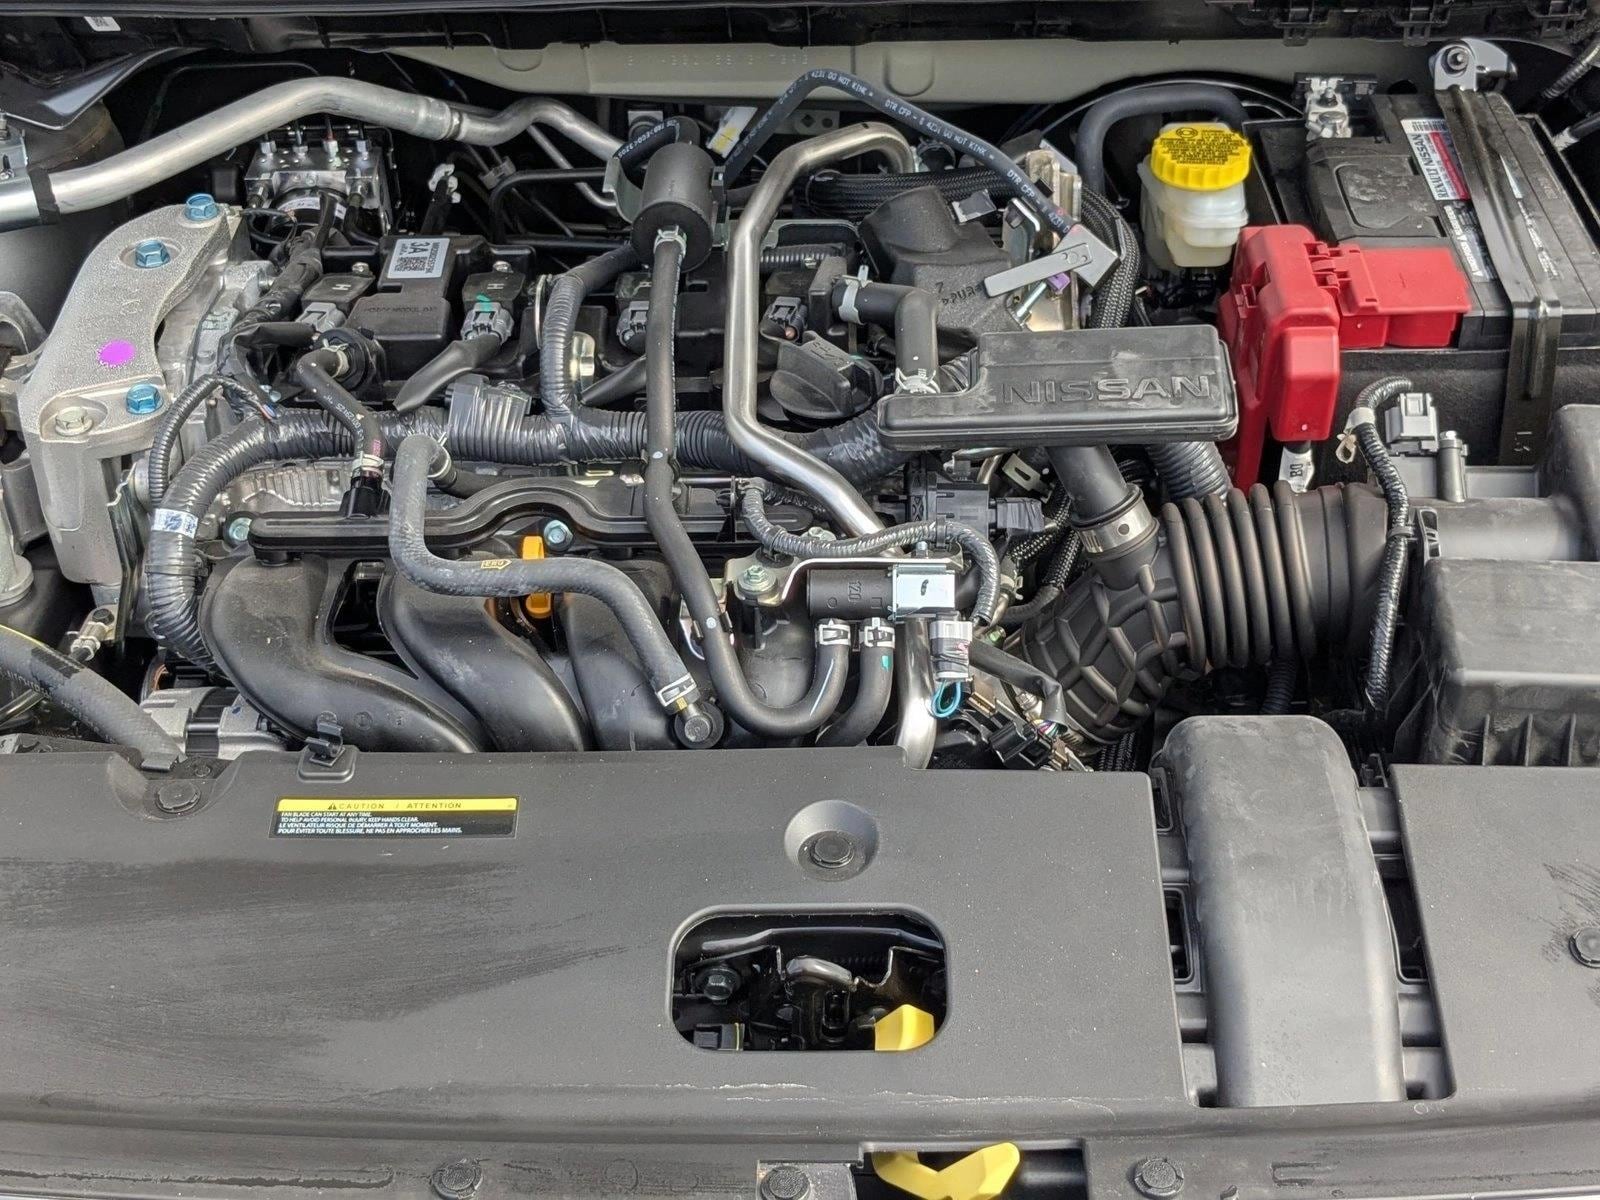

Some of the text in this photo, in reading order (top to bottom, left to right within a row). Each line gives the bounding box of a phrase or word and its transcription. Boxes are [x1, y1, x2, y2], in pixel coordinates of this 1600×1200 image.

[1411, 134, 1436, 167] NISSAN
[1426, 165, 1450, 199] RENAULT
[408, 241, 431, 255] 3A
[1002, 375, 1211, 404] NISSAN
